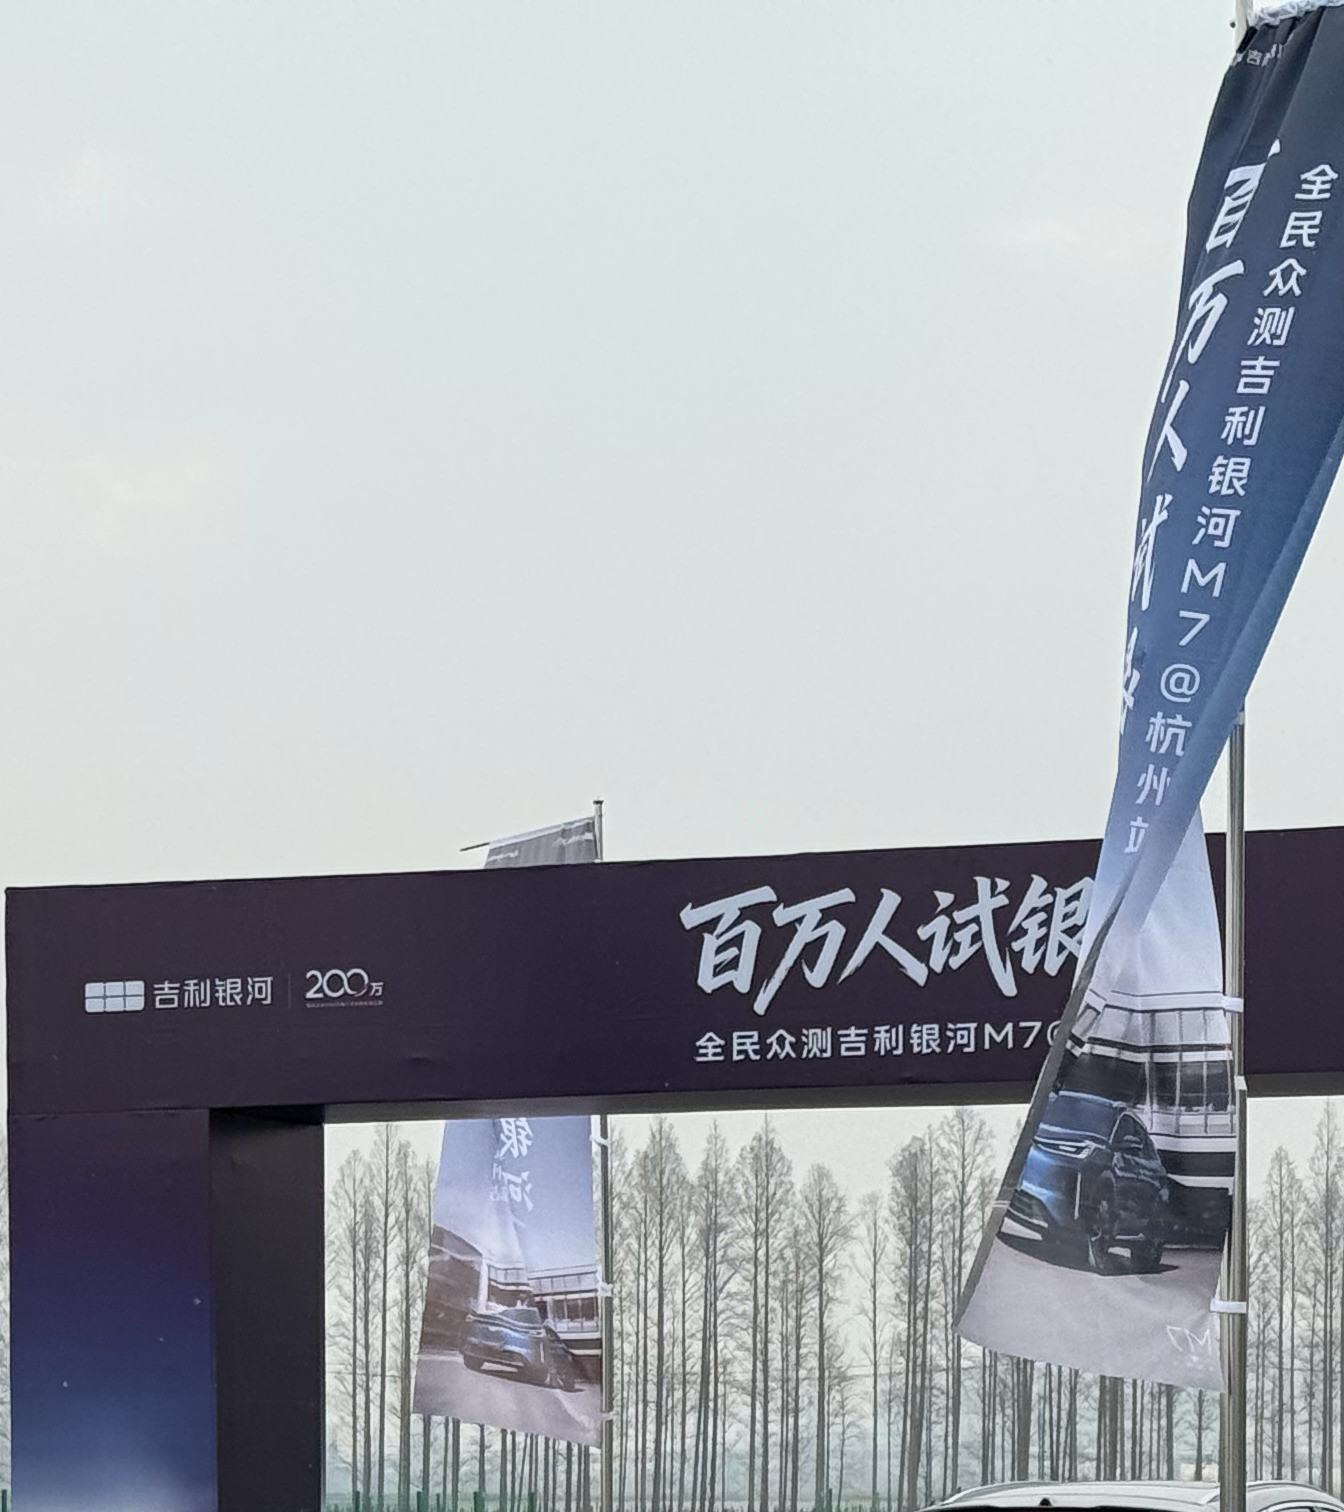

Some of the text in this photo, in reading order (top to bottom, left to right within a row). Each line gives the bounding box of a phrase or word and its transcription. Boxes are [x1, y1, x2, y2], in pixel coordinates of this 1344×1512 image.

[152, 967, 385, 1009] 吉利银河 200万
[679, 872, 1096, 1016] 百万人试银
